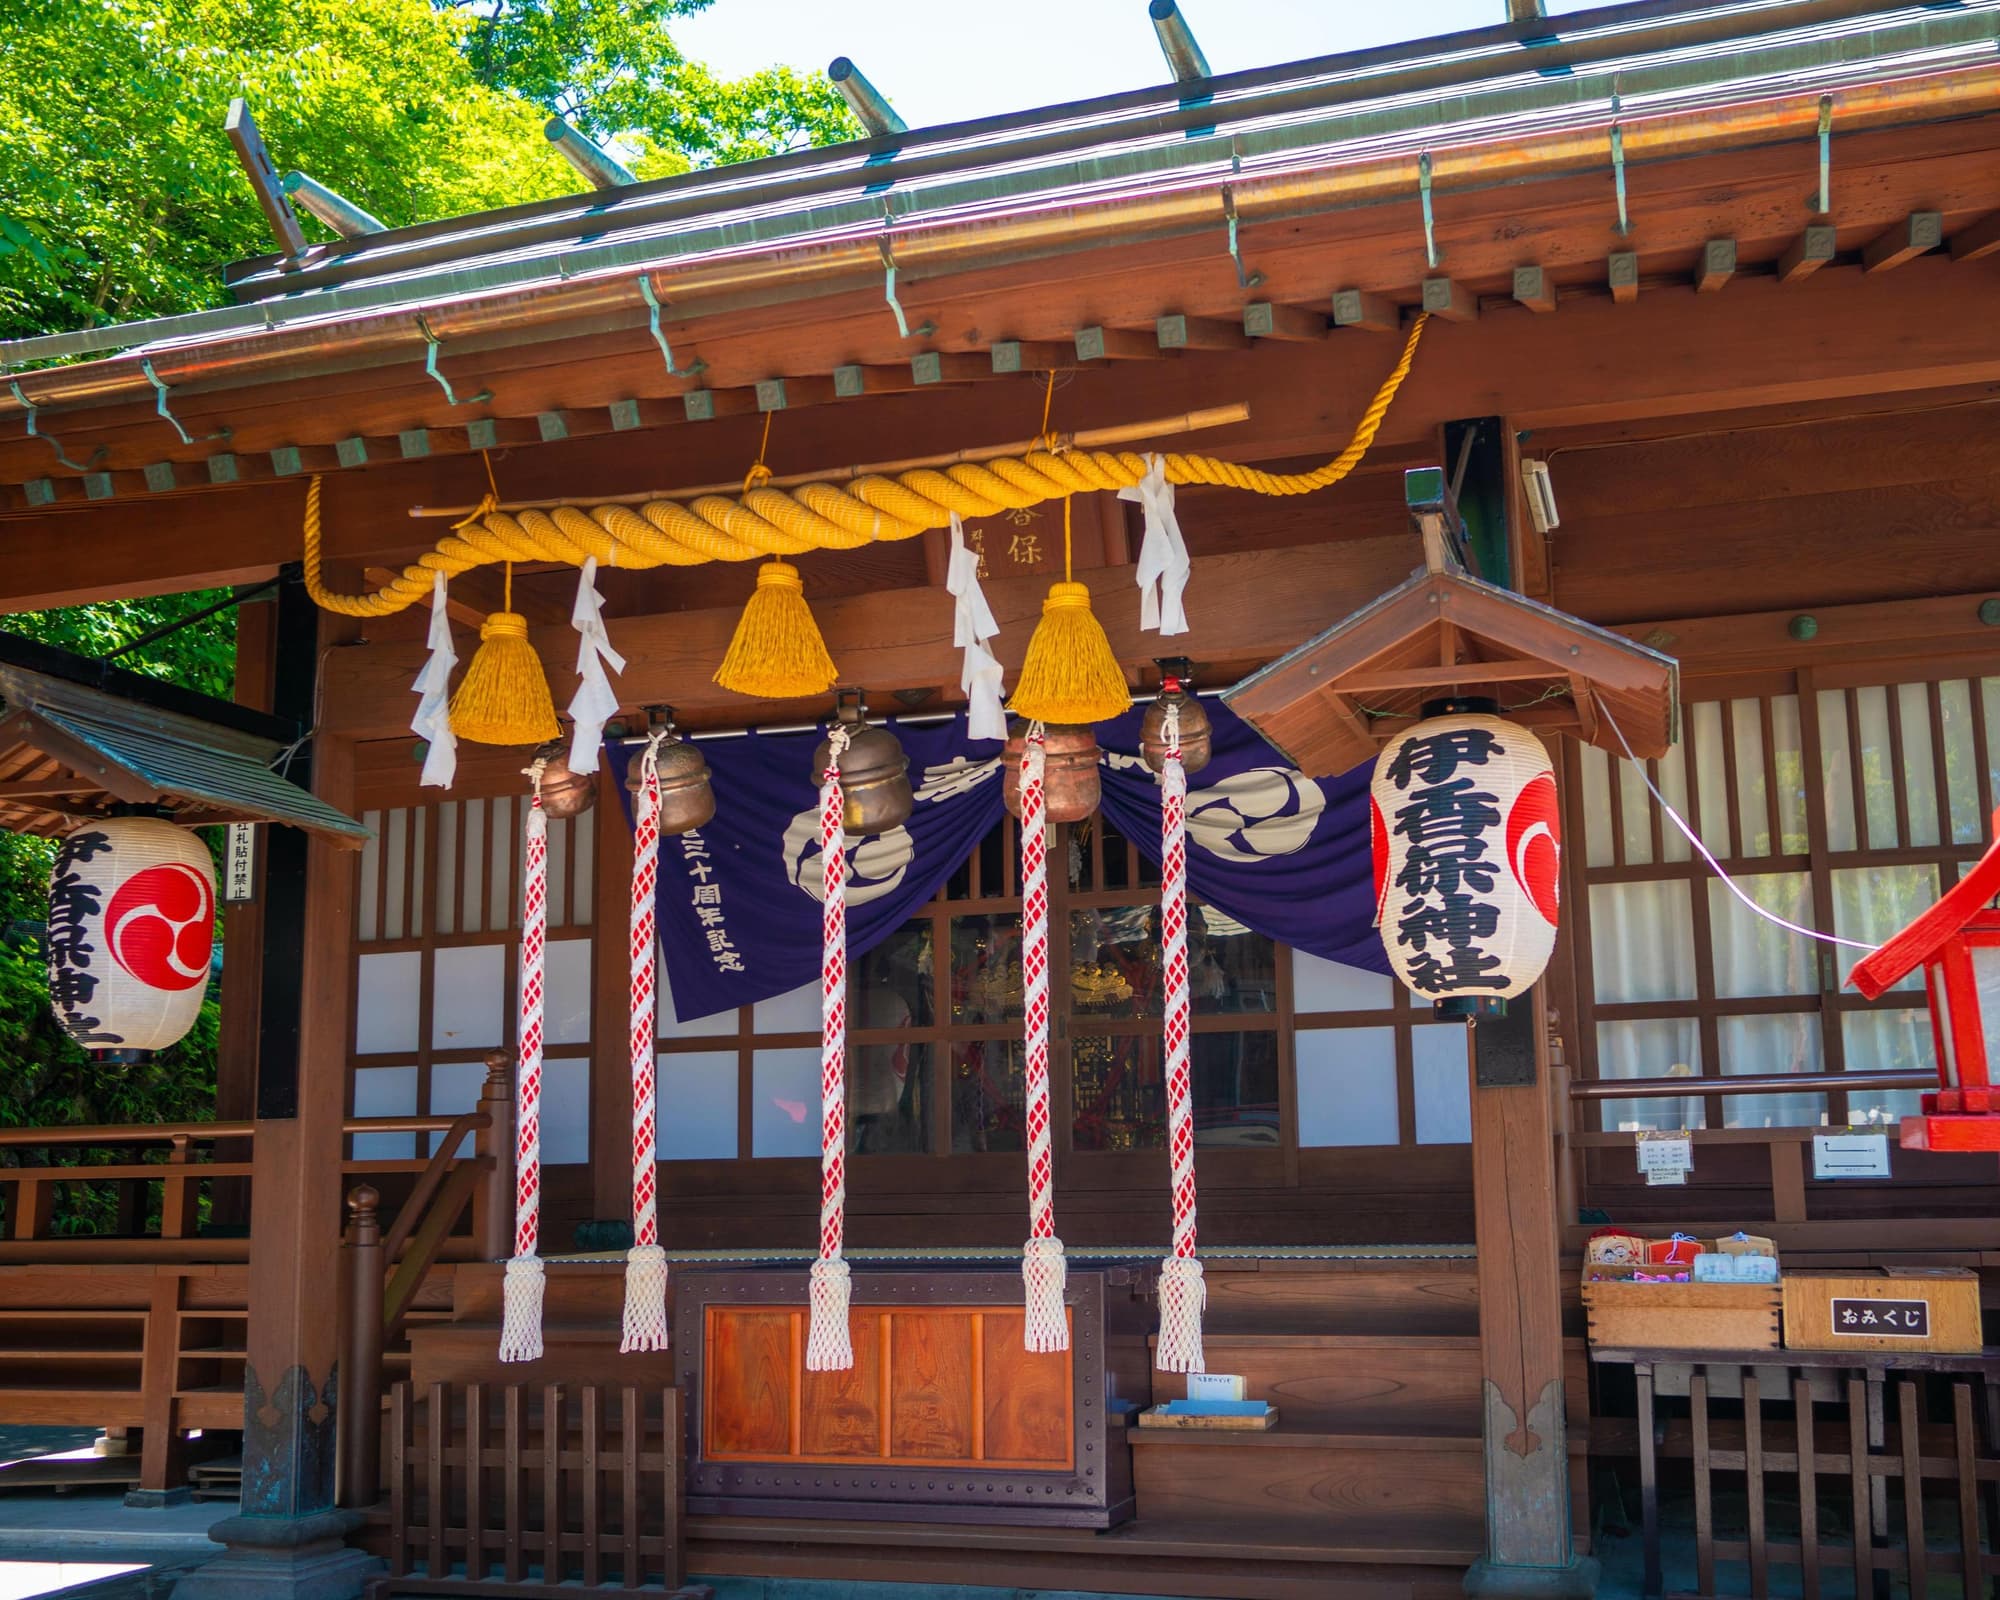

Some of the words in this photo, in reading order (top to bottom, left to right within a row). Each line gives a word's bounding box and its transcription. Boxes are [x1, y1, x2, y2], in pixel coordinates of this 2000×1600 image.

[1385, 729, 1511, 993] 伊香保神社
[1842, 1308, 1920, 1327] おみくじ
